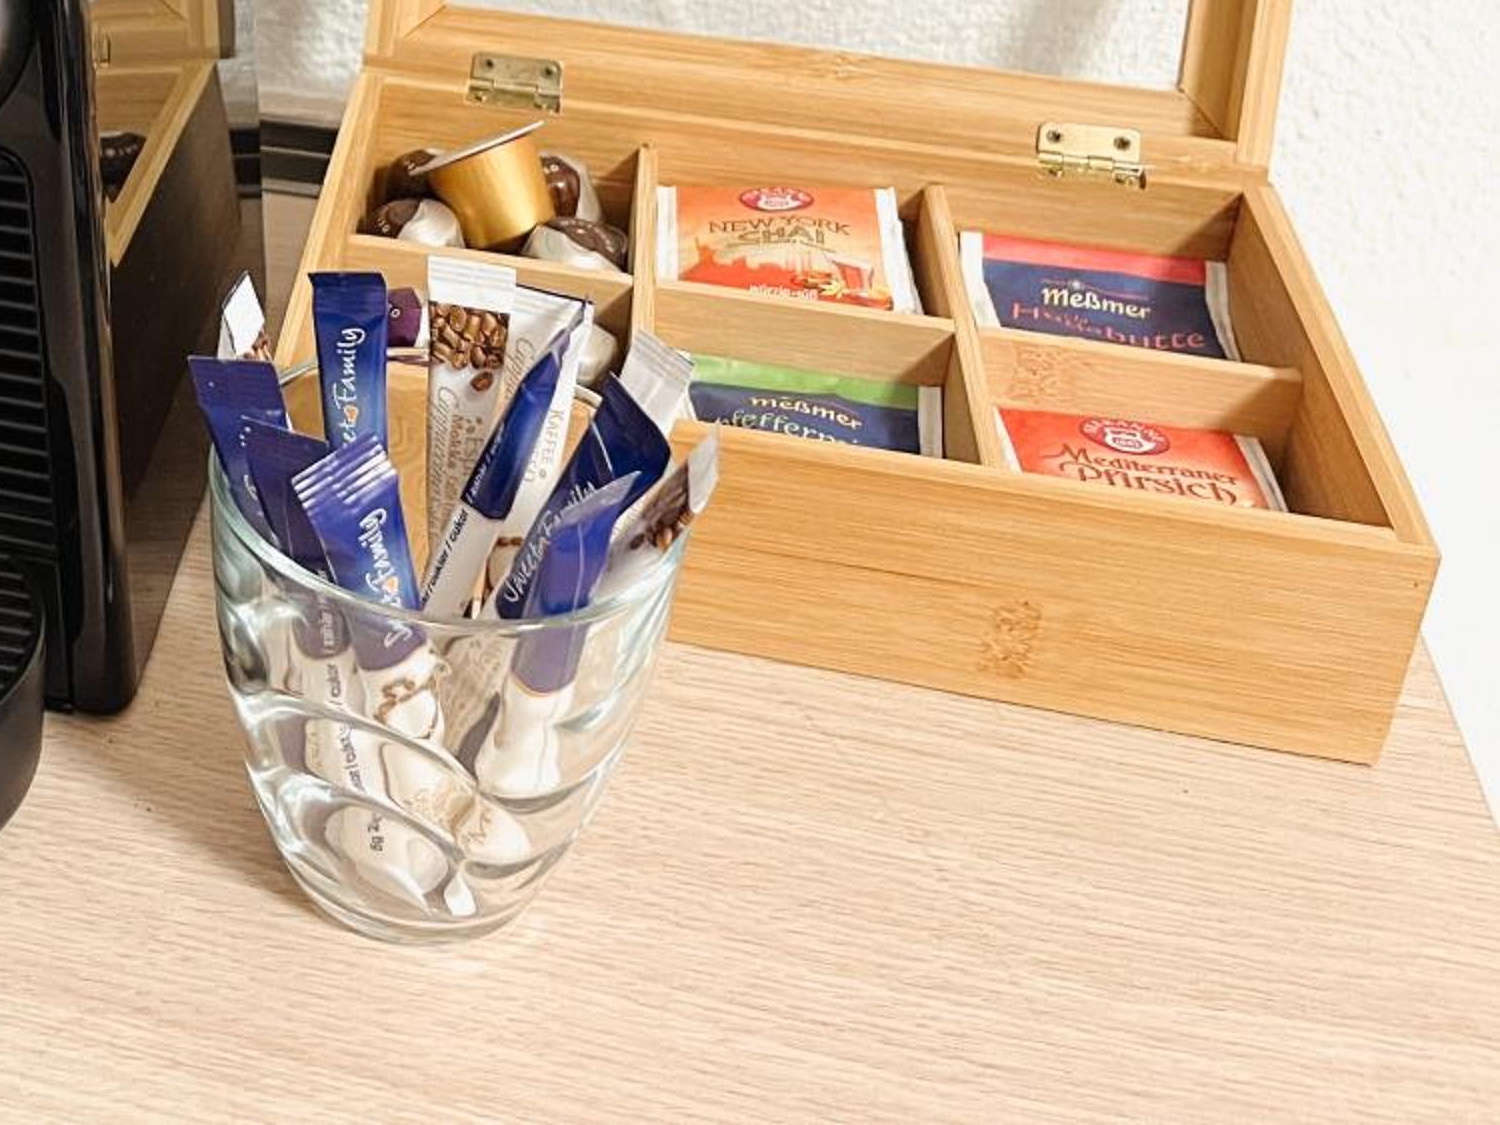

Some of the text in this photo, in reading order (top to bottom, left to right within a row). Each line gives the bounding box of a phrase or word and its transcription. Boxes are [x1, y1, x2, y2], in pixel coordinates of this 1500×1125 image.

[709, 214, 852, 236] NEW YORK
[737, 224, 825, 245] CHAI
